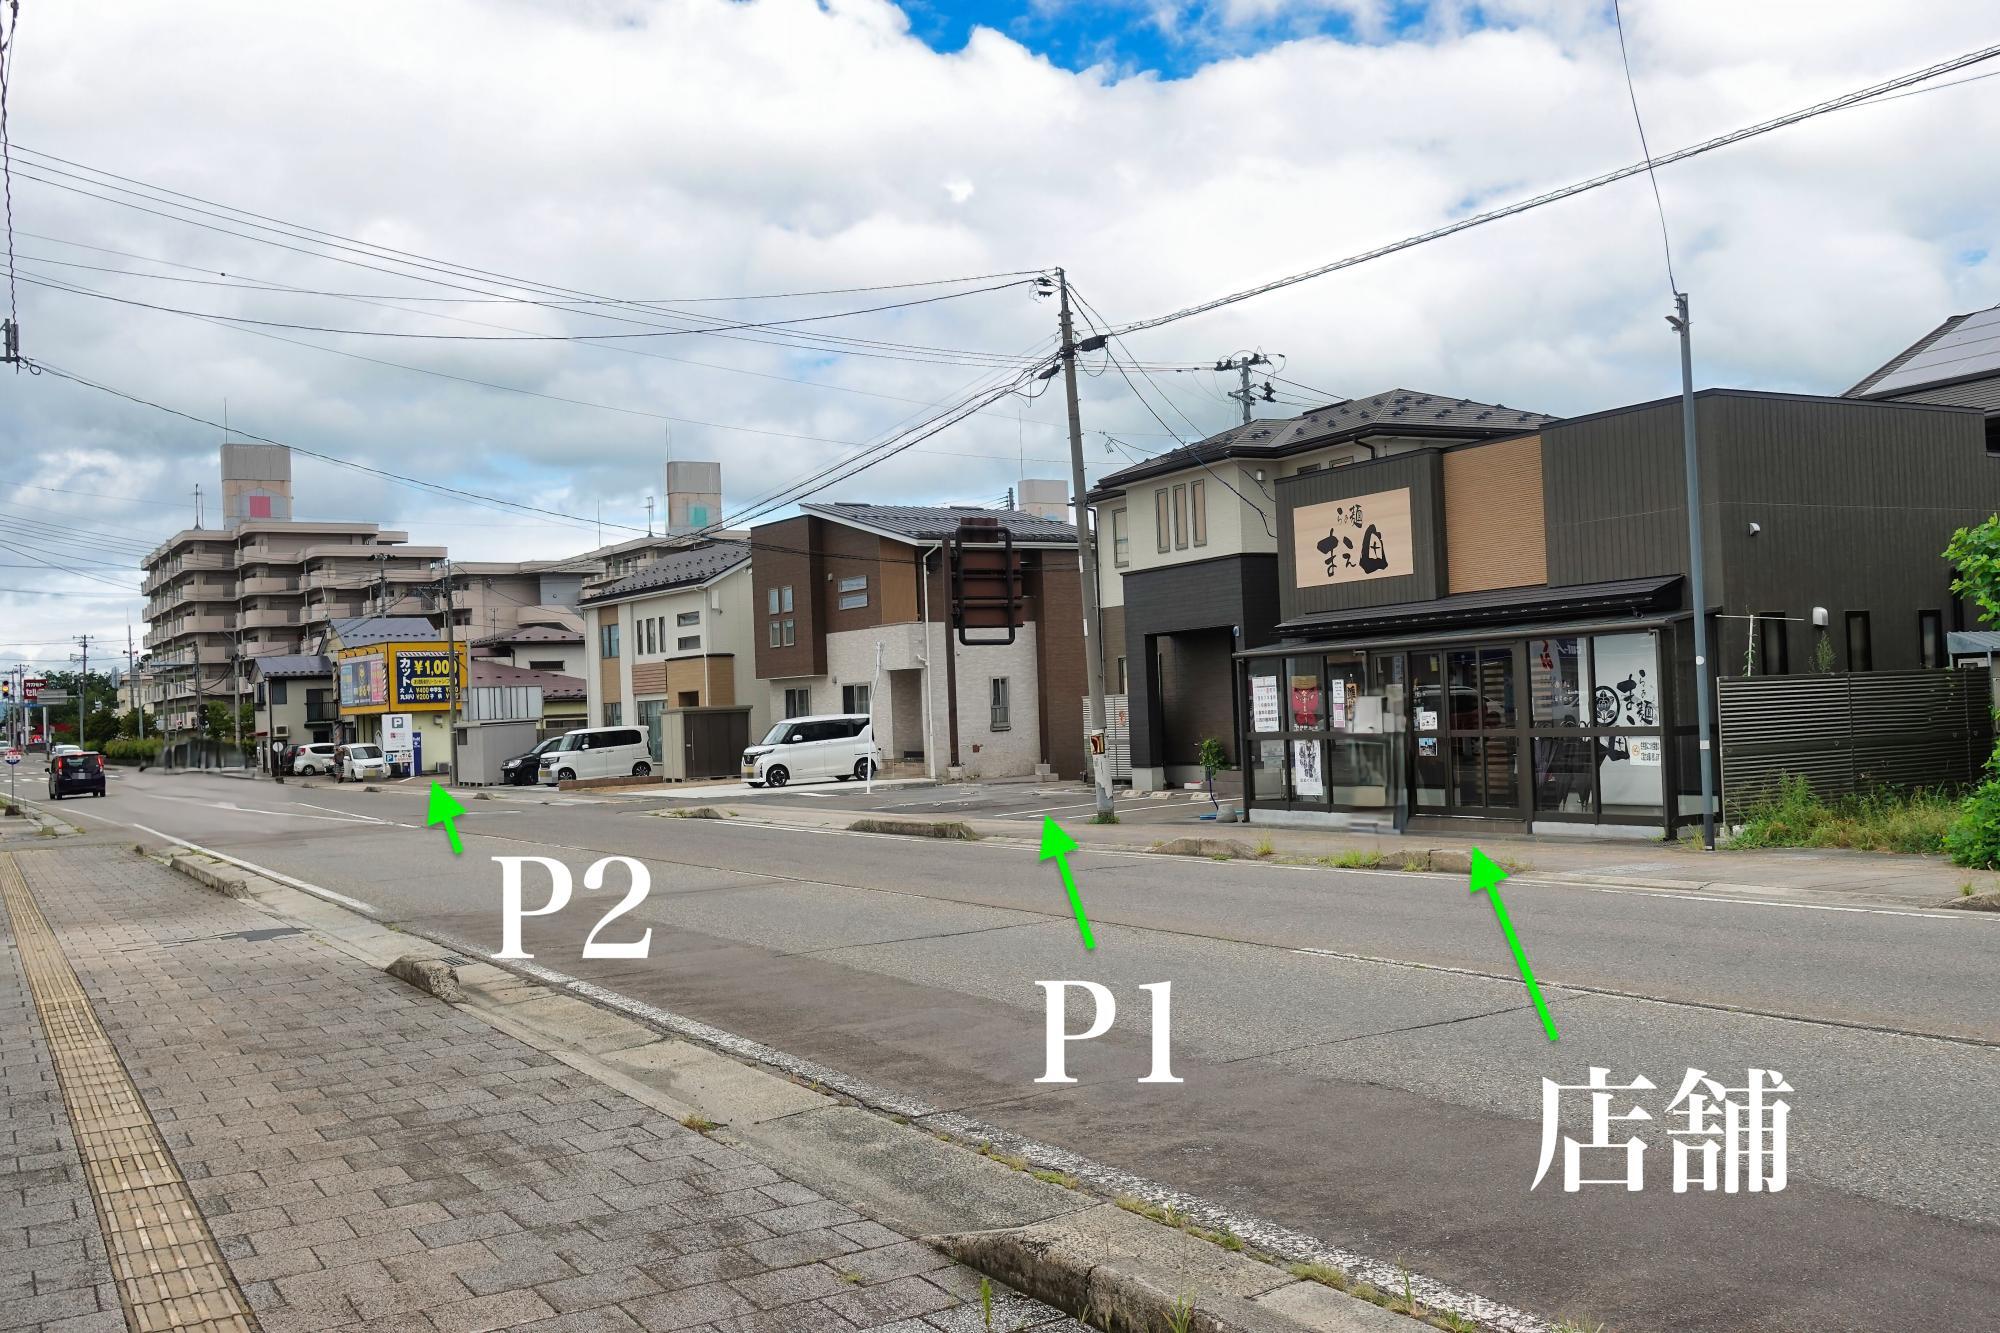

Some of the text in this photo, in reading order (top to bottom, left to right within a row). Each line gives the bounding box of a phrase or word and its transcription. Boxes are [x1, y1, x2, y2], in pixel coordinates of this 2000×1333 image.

[1337, 504, 1363, 528] らぁ麺
[1317, 524, 1388, 577] まえ田
[400, 658, 411, 687] カット
[393, 718, 402, 727] P
